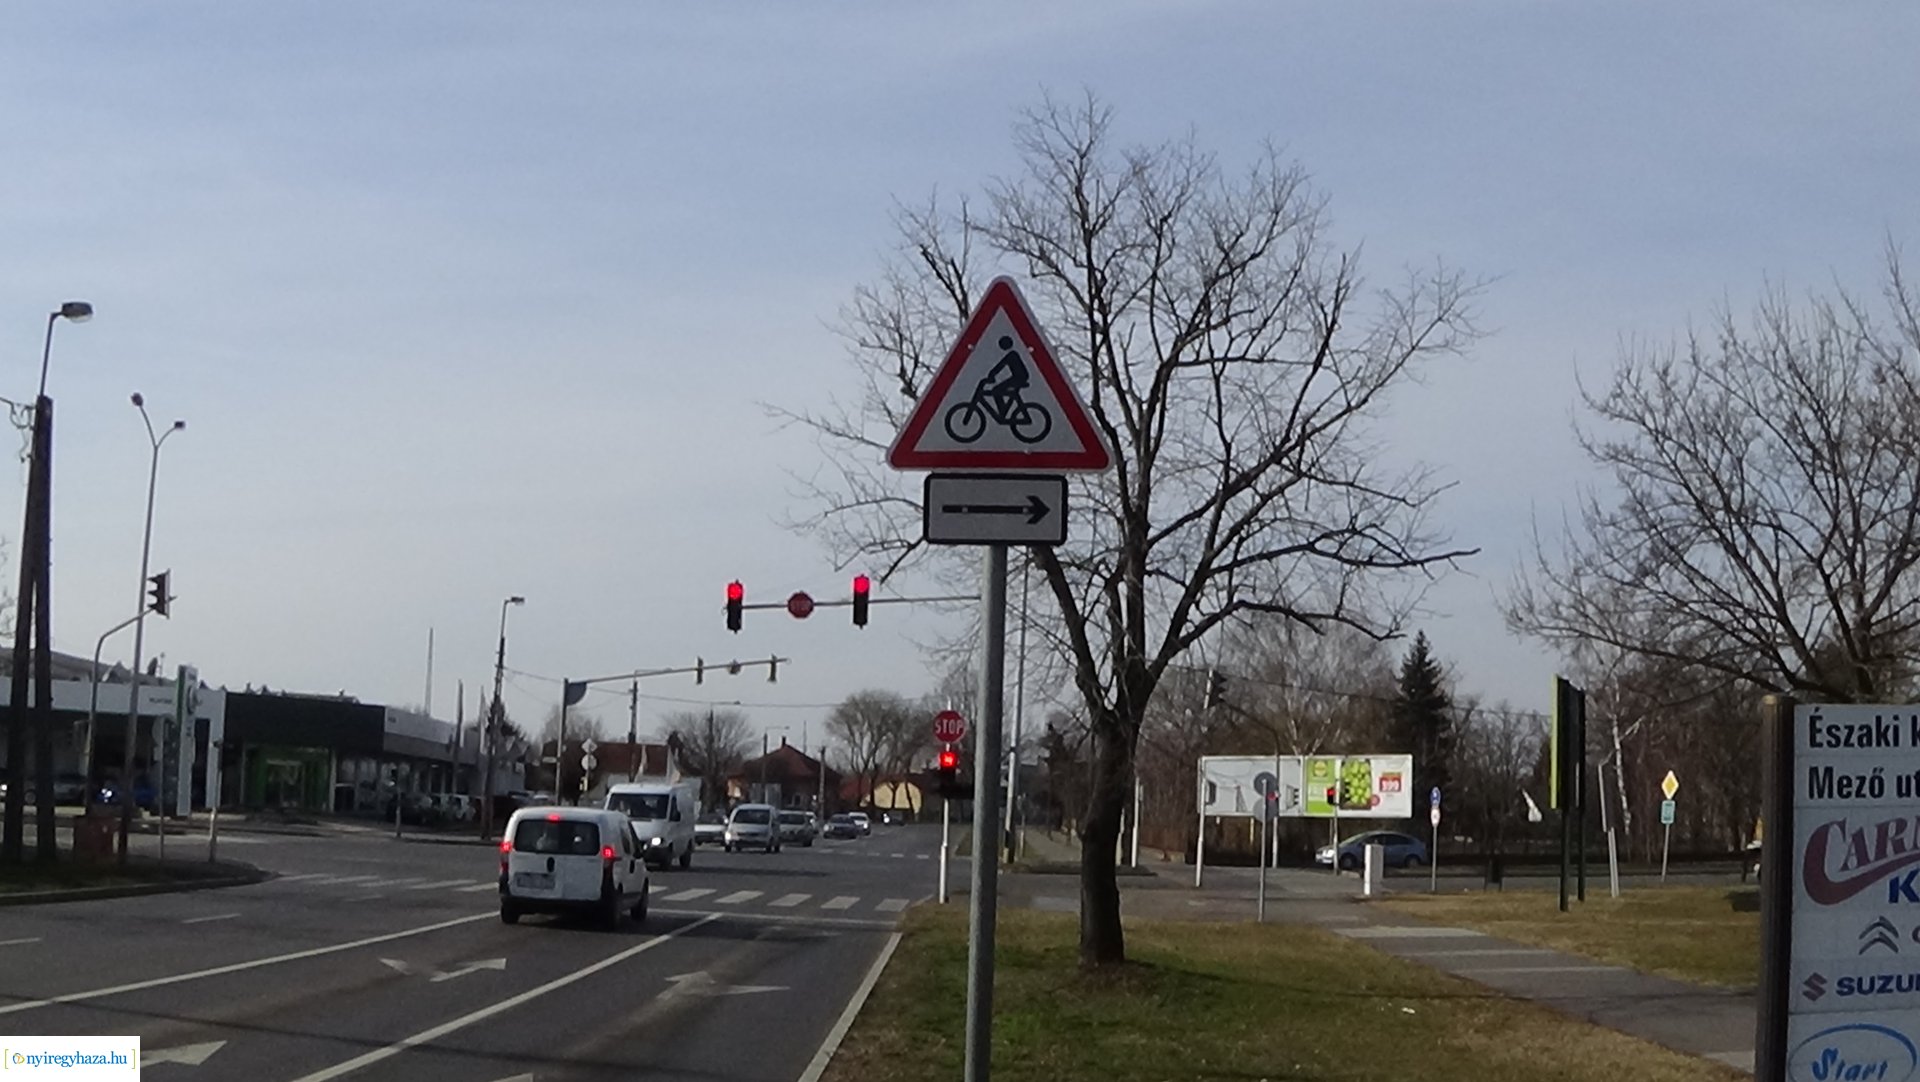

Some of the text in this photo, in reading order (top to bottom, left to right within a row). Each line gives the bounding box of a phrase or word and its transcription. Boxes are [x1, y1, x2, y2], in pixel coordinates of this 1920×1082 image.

[935, 718, 964, 735] STOP
[1809, 706, 1900, 748] Északi
[1808, 766, 1885, 799] Mező
[1803, 815, 1920, 905] CAR
[1836, 973, 1920, 996] SUZU
[1811, 1047, 1888, 1081] Start
